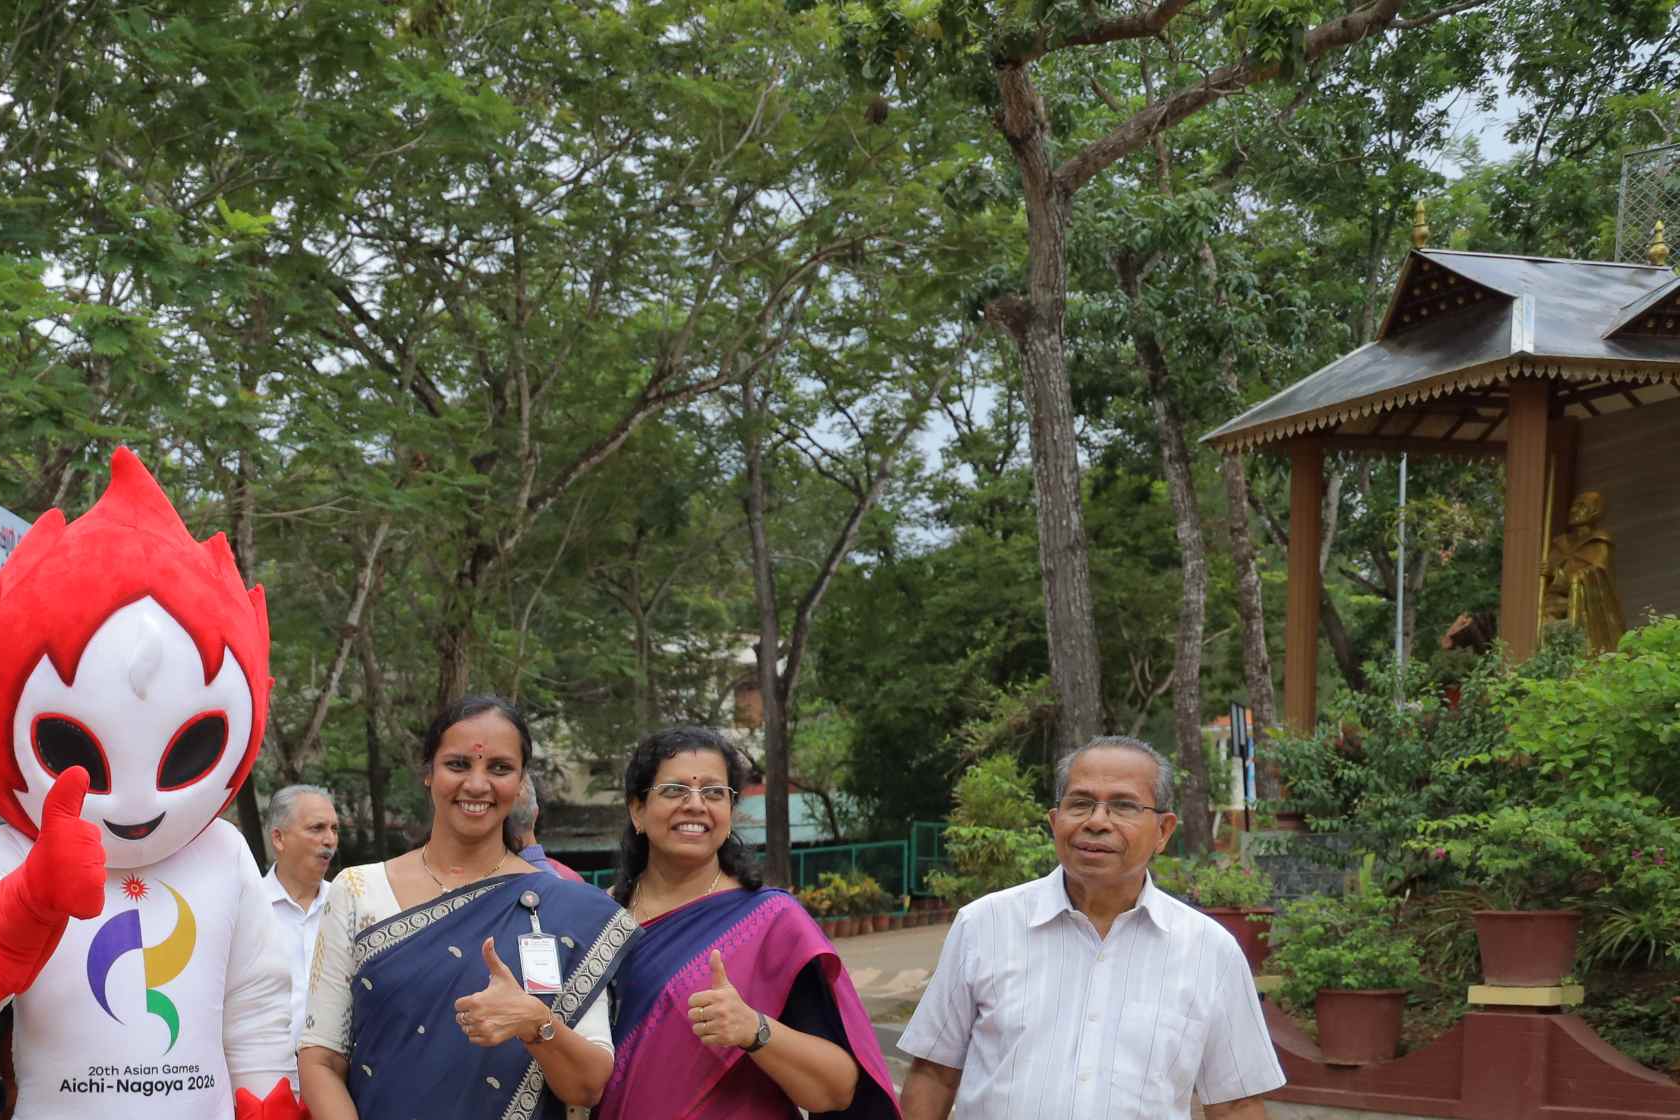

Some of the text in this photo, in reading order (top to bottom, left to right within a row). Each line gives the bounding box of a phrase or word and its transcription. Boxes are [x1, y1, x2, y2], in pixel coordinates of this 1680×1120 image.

[87, 1063, 200, 1077] 20th Asian Games
[59, 1073, 216, 1097] Aichi-Nagoya 2026
